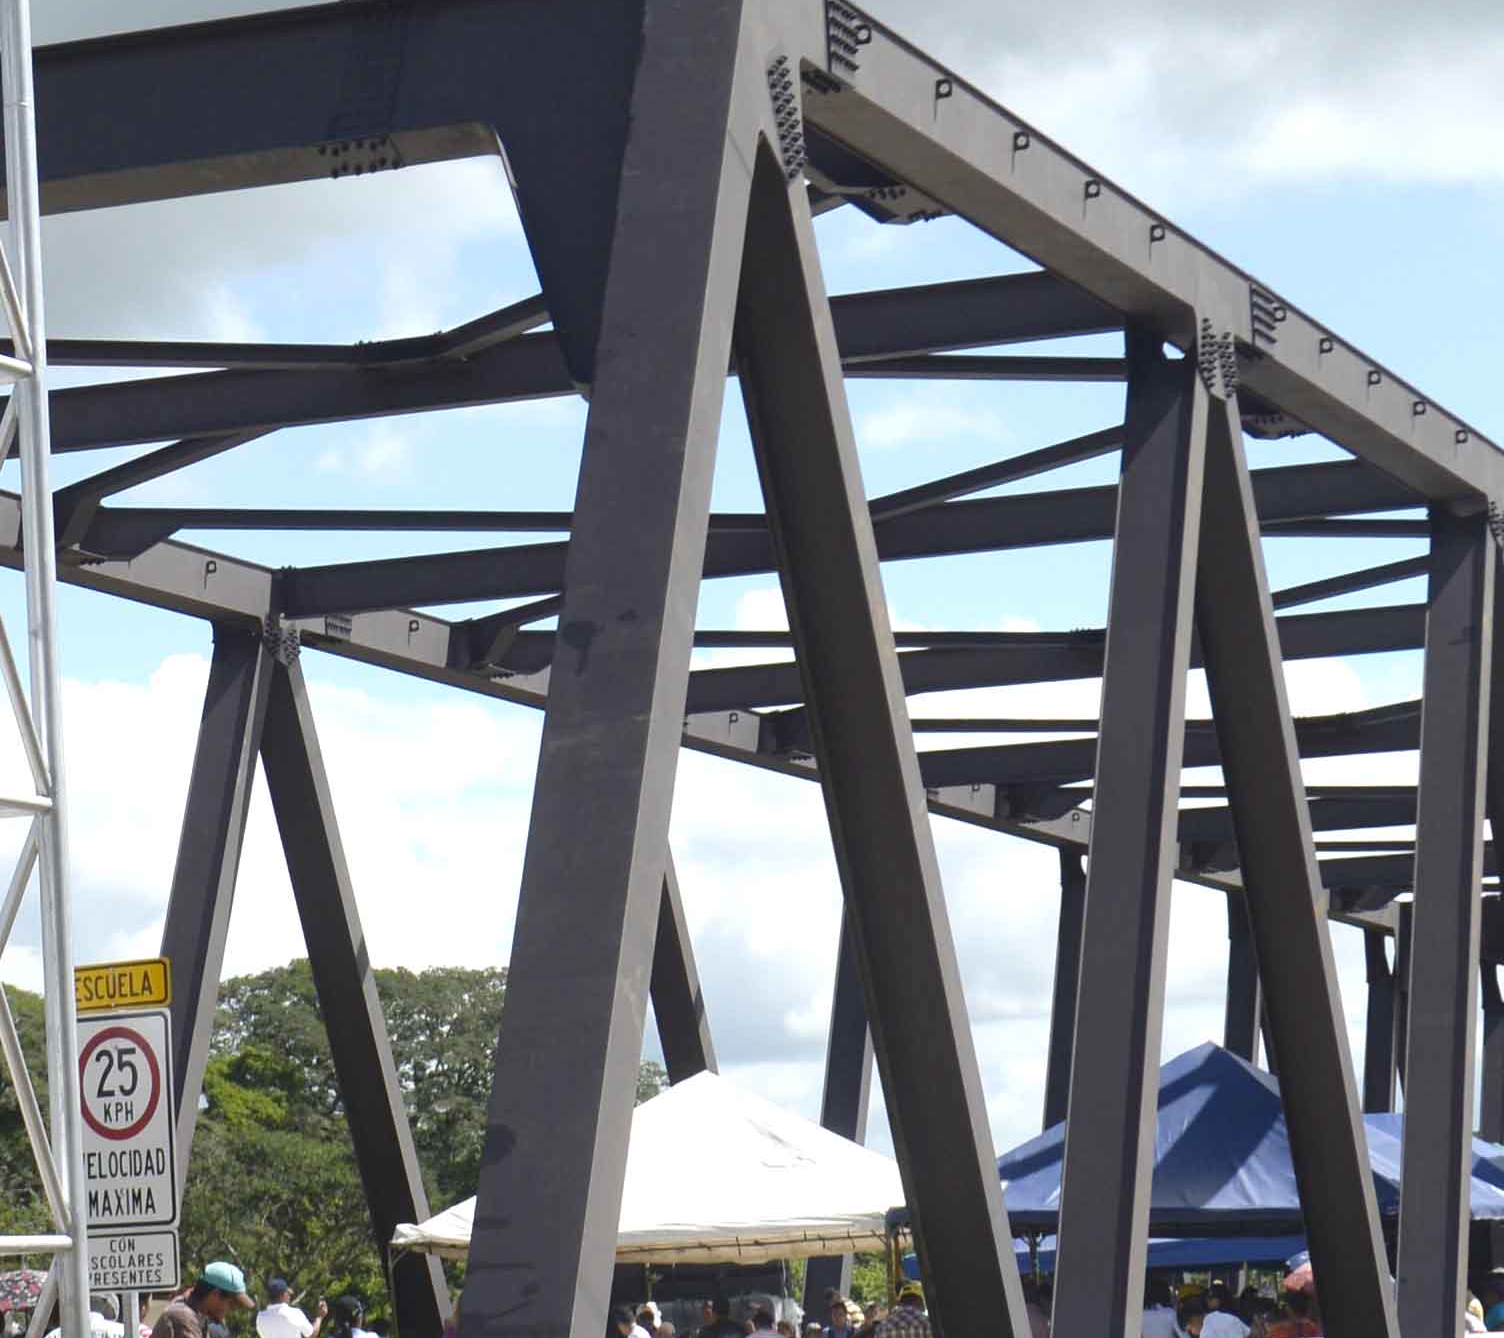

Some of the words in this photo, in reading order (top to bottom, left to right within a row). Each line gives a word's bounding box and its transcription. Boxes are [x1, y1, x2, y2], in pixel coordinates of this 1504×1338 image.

[75, 970, 153, 1002] ESCUELA
[95, 1047, 138, 1098] 25
[103, 1101, 134, 1123] KPH
[83, 1148, 166, 1179] ELOCIDAD
[88, 1187, 156, 1218] MAXIMA
[89, 1253, 164, 1270] SCOLARES
[89, 1269, 162, 1286] RESENTES
